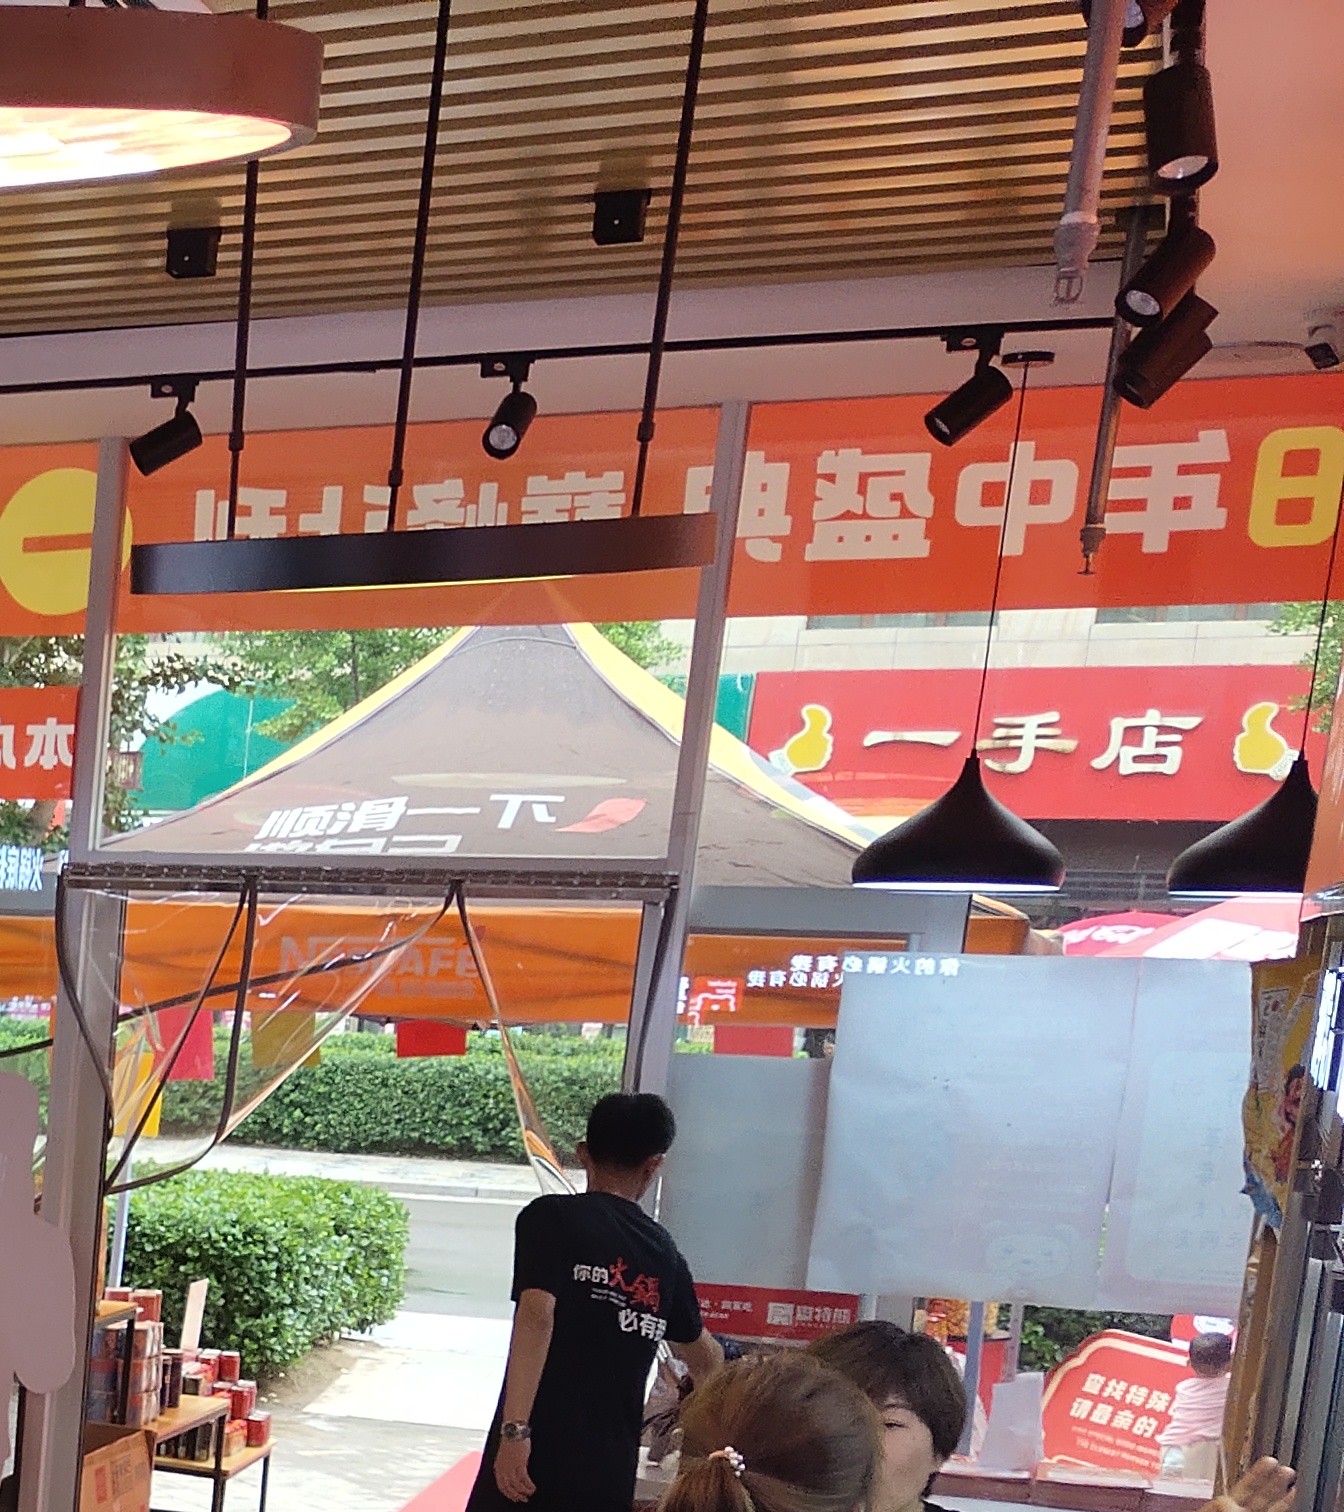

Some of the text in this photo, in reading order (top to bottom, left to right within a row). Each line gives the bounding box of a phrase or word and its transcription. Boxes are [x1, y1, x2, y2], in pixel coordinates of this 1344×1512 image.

[861, 709, 1206, 776] 一手店
[256, 793, 564, 839] 顺滑一下
[1069, 1397, 1162, 1443] 请最亲的
